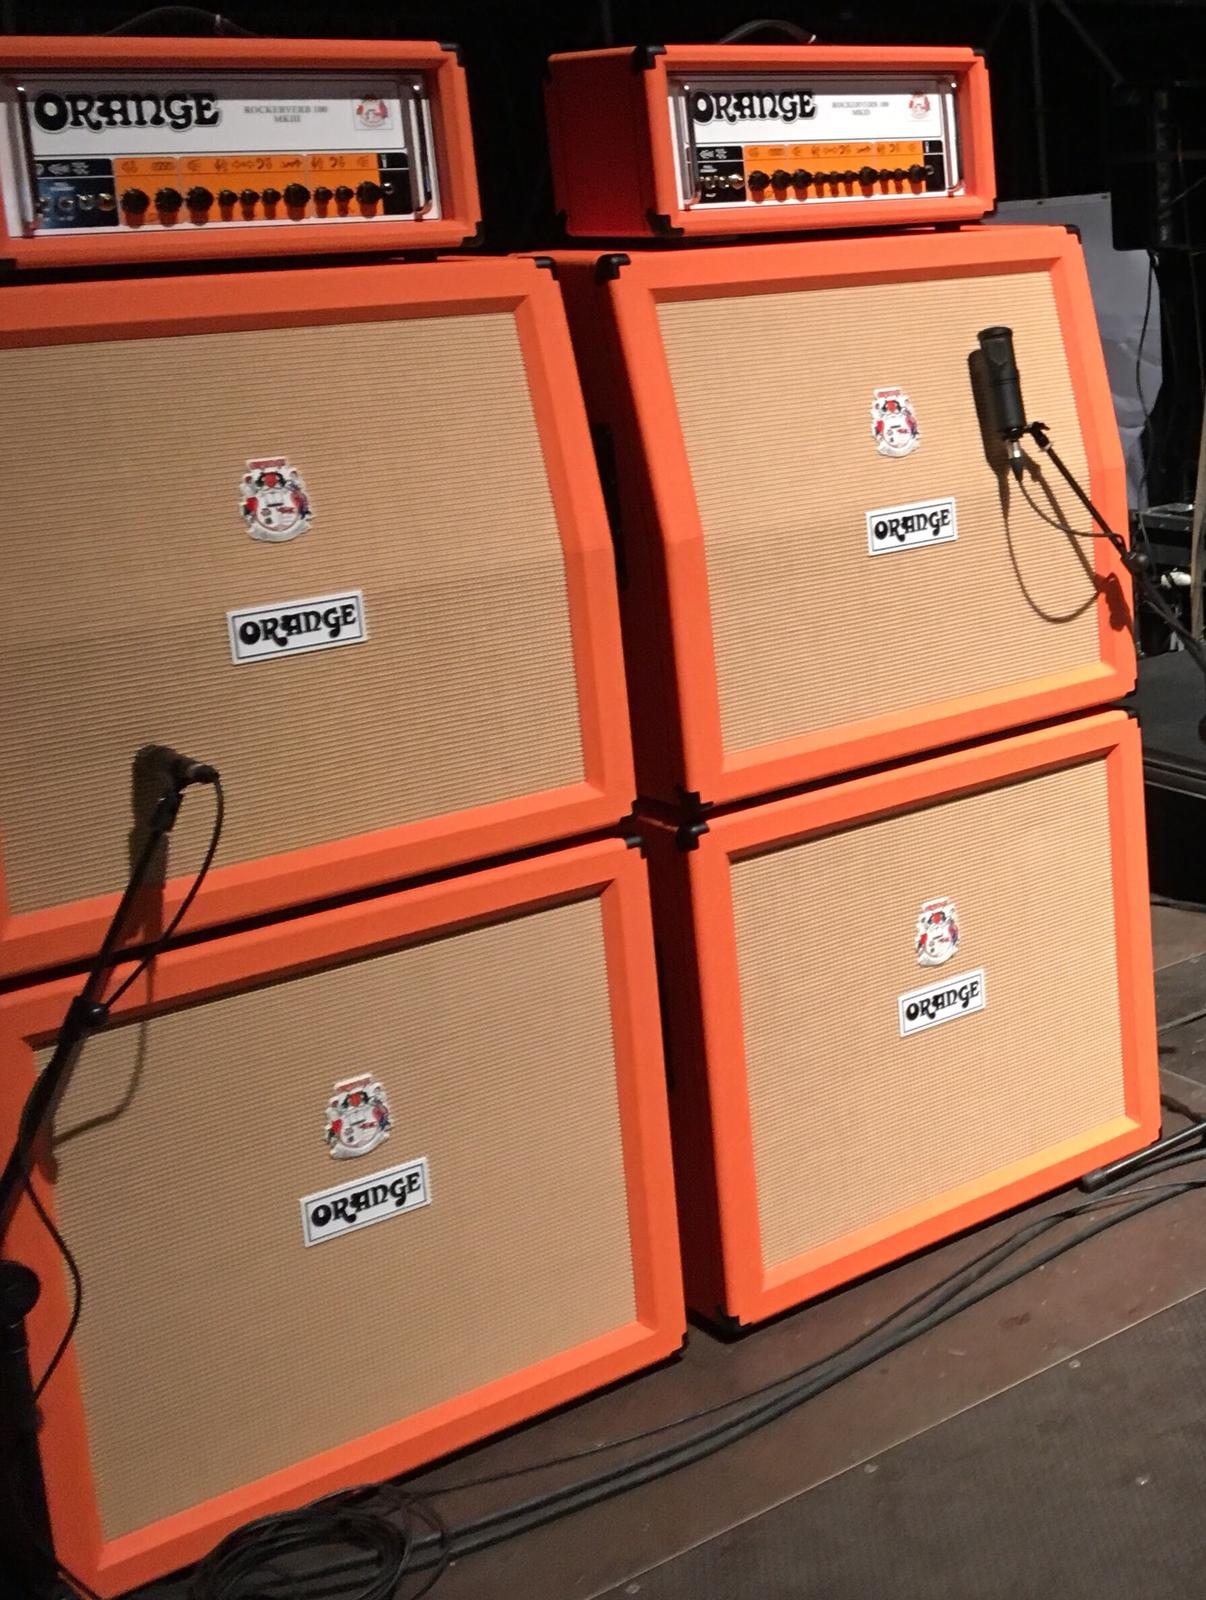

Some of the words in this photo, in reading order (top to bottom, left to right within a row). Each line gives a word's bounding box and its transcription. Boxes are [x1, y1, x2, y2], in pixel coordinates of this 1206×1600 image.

[34, 92, 220, 131] ORANGE
[693, 91, 816, 123] ORANGE
[874, 508, 950, 542] ORANGE
[239, 603, 356, 647] ORANGE
[906, 980, 979, 1020] ORANGE
[311, 1171, 421, 1227] ORANGE
